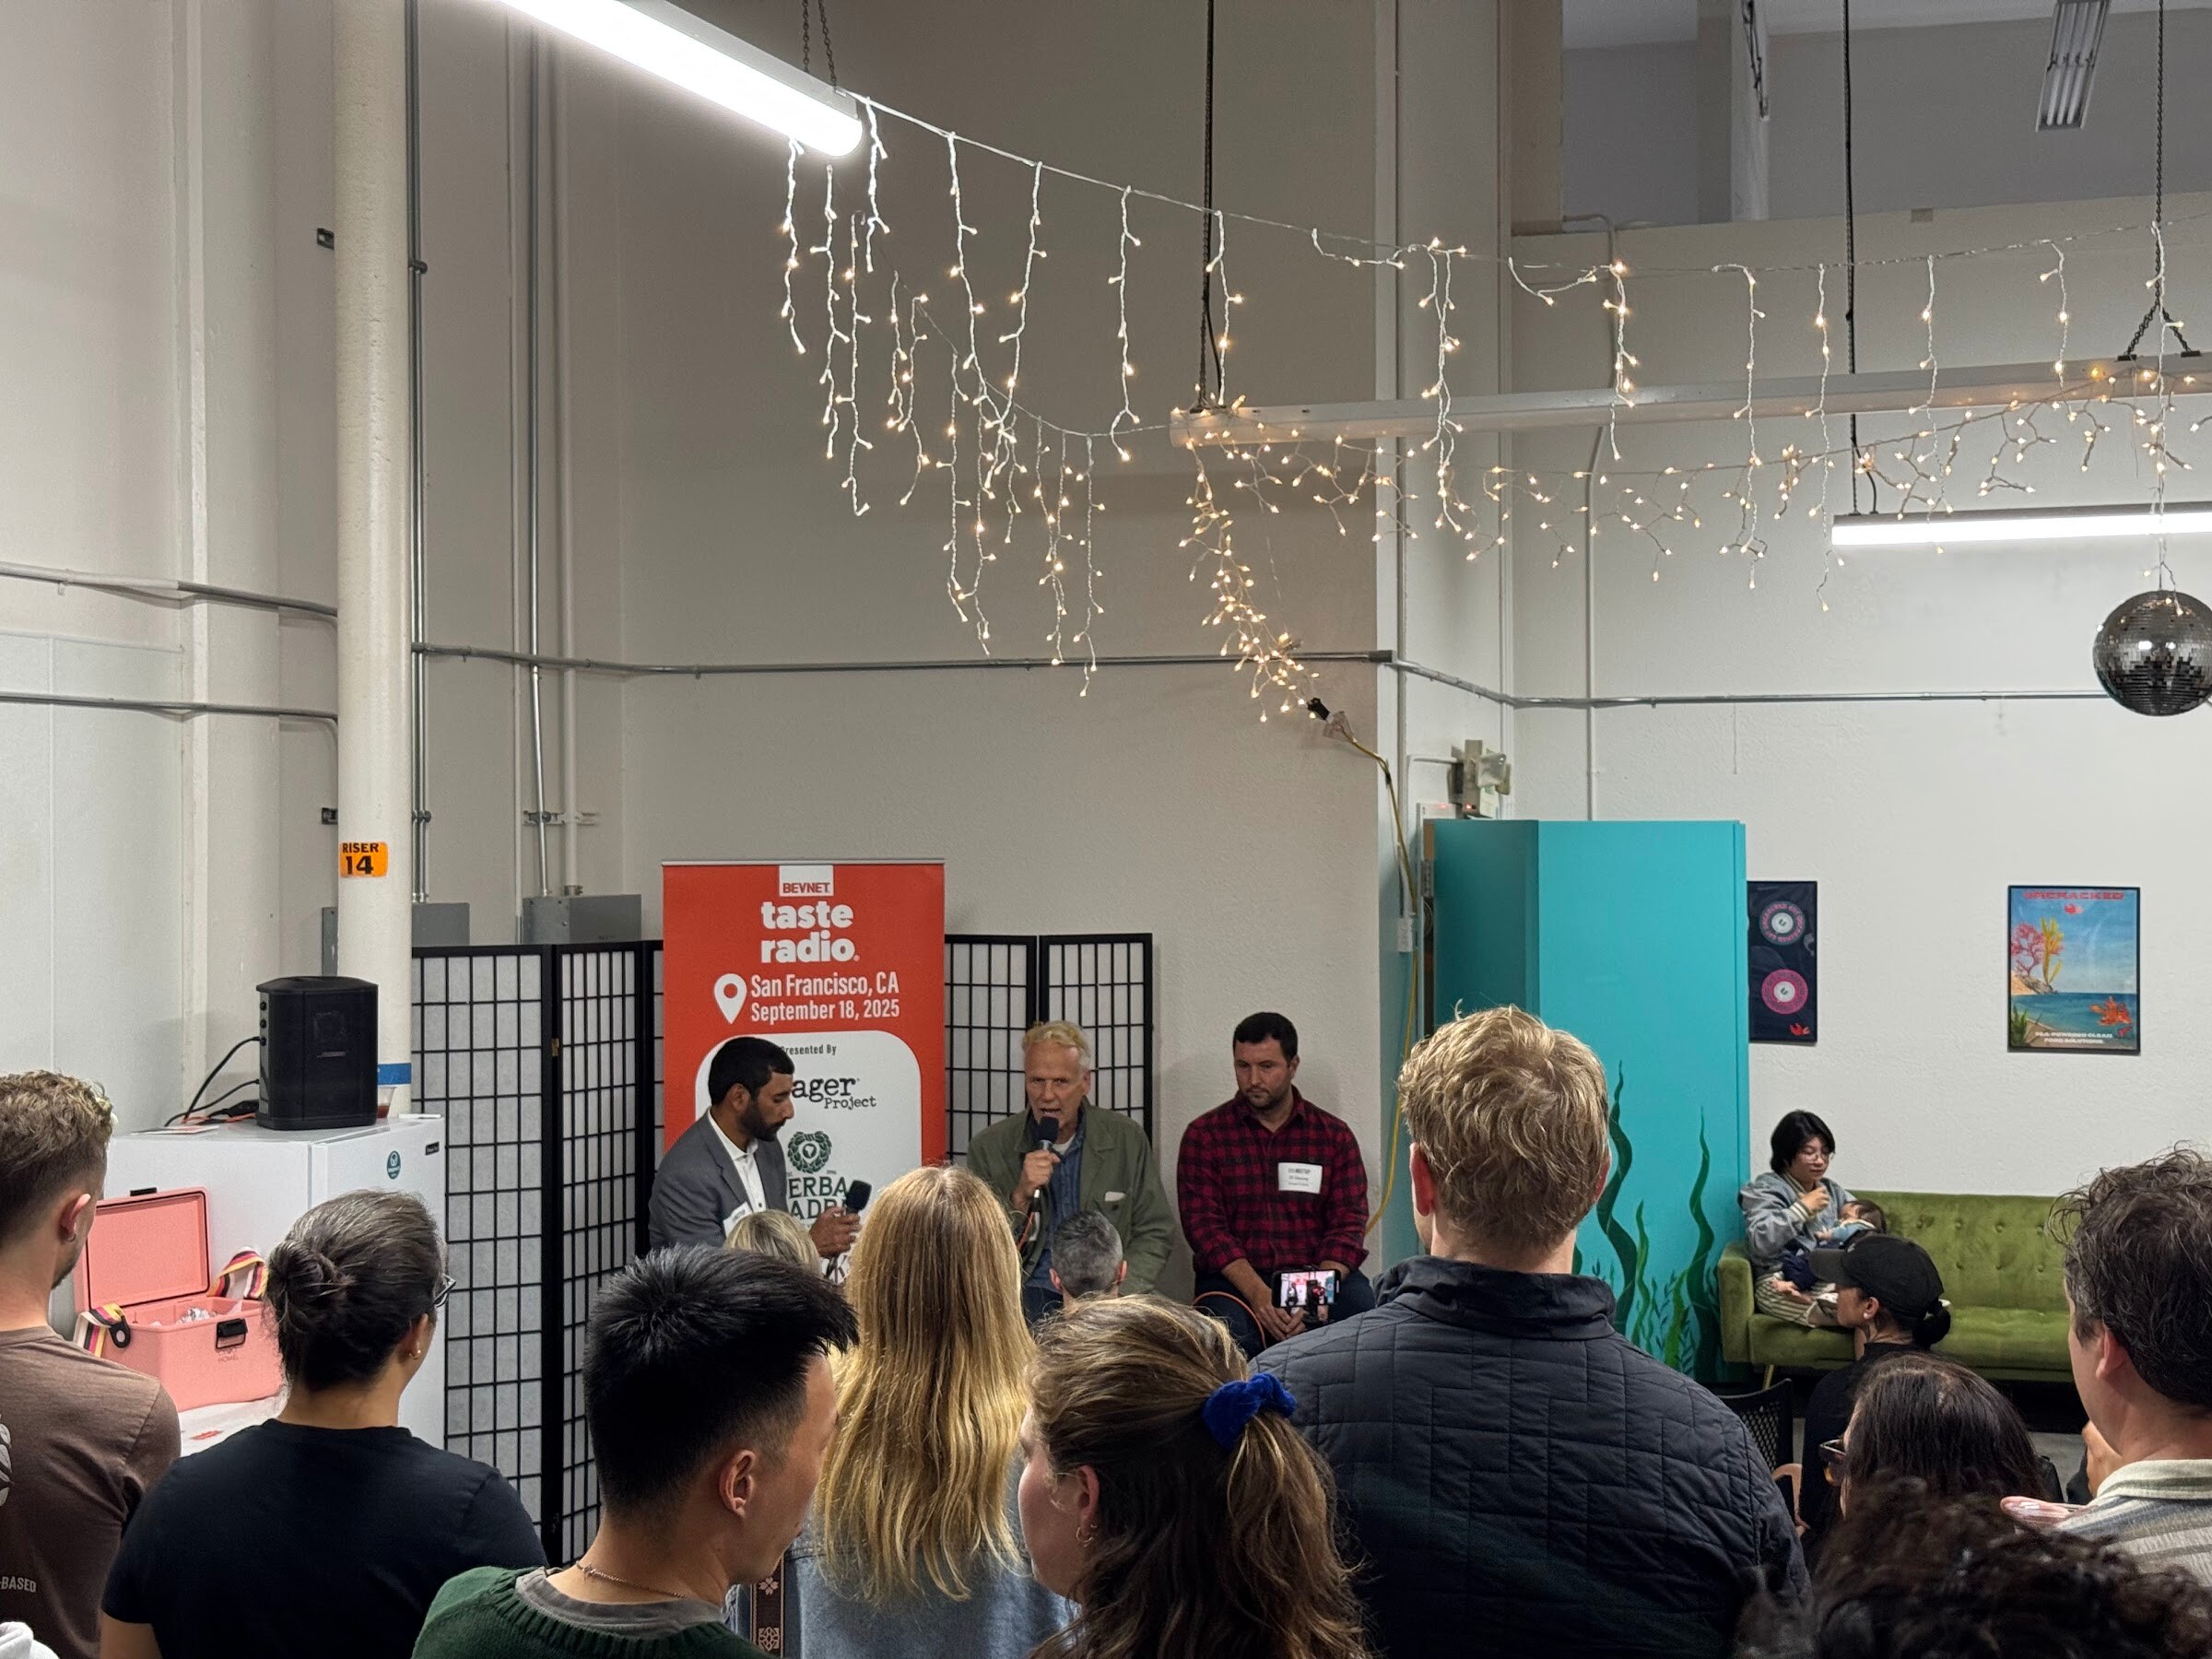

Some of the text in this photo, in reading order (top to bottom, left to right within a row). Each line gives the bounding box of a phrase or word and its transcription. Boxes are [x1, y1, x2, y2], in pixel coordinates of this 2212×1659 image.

[342, 842, 379, 853] RISER
[346, 855, 373, 875] 14
[782, 883, 830, 894] BEVNET
[761, 900, 853, 929] taste
[750, 971, 900, 997] San Francisco, CA
[751, 999, 900, 1025] September 18, 2025
[827, 1043, 837, 1056] By
[792, 1077, 856, 1102] ager
[824, 1096, 877, 1110] Project
[788, 1176, 848, 1198] ERBA
